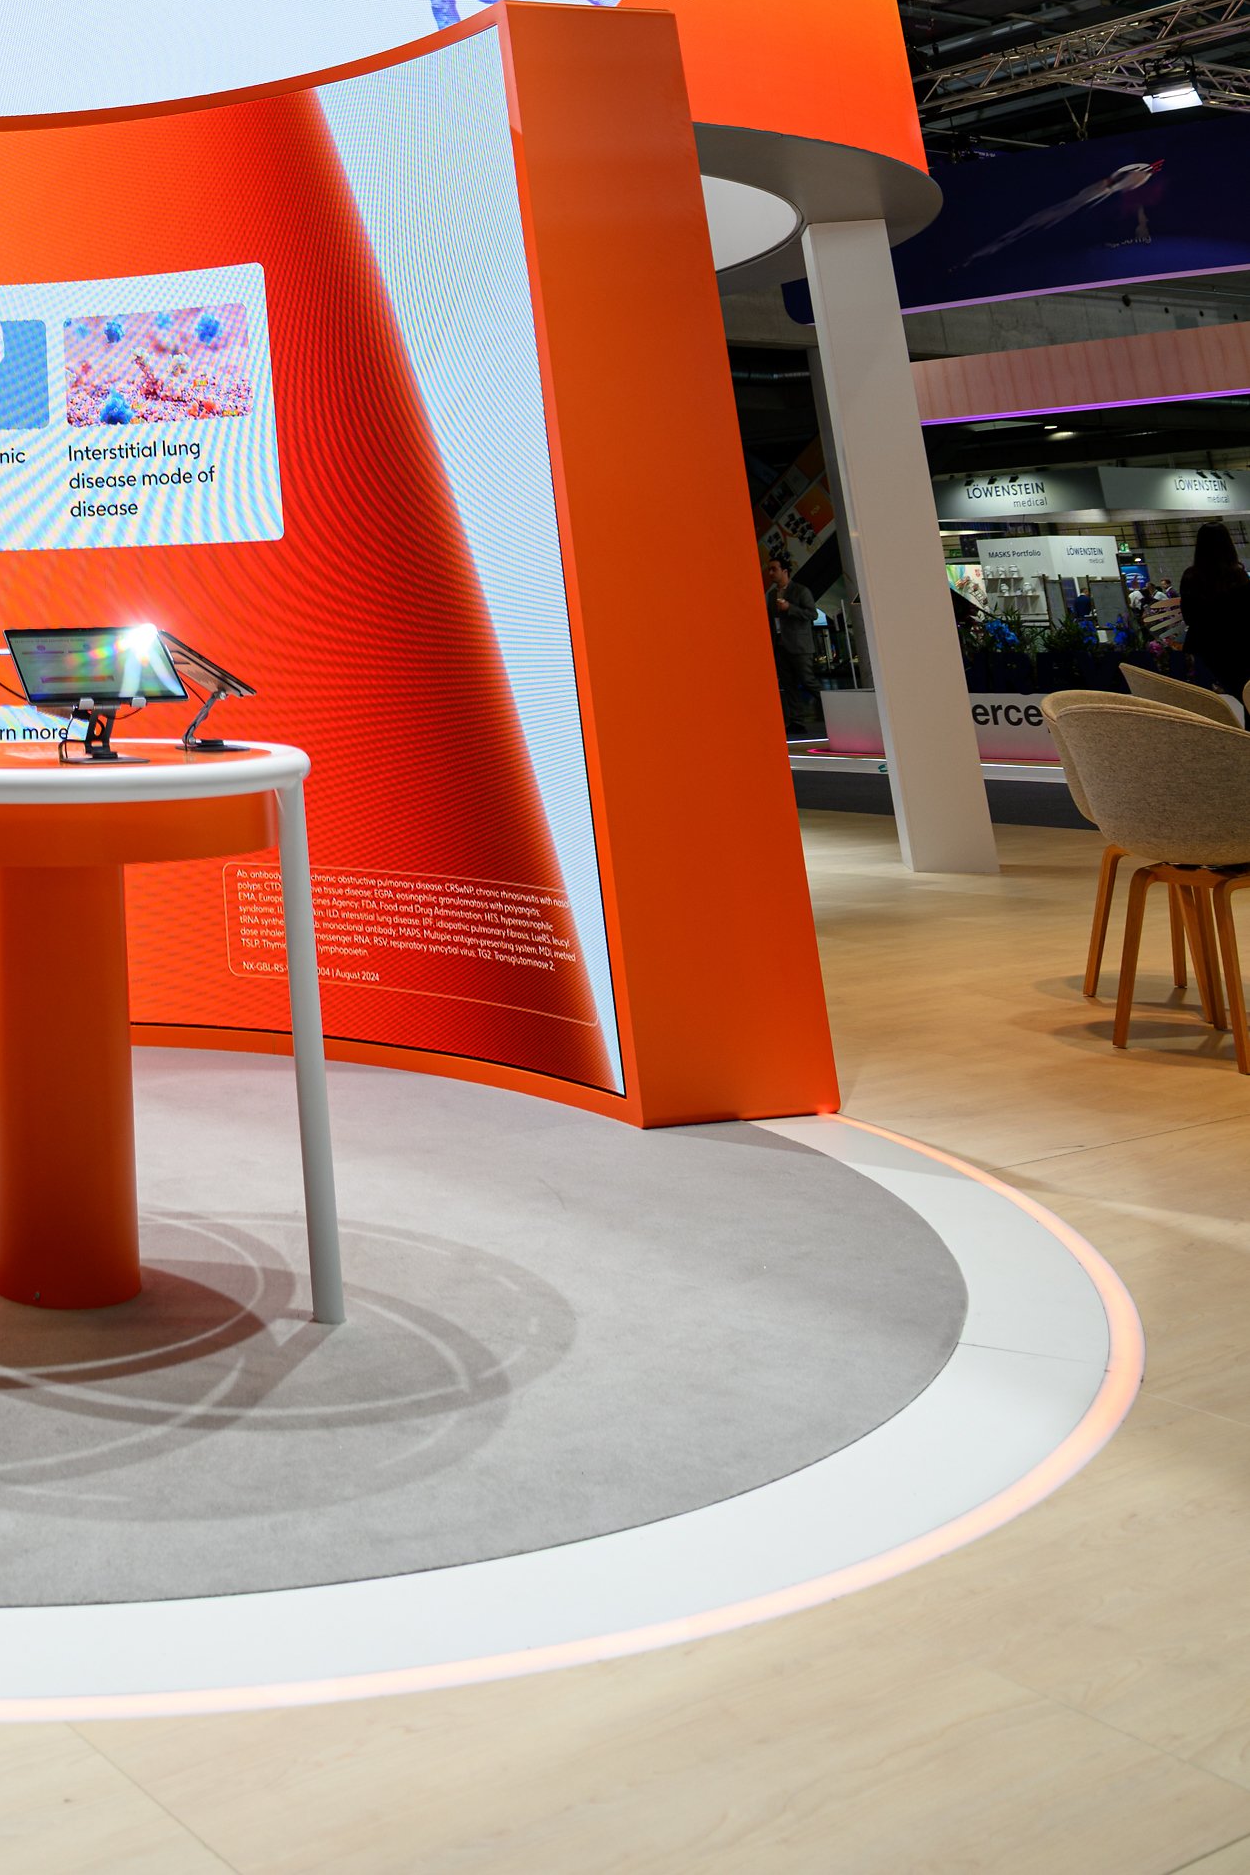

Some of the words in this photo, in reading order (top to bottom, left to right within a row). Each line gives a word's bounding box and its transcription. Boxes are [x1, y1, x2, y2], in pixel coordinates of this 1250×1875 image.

[68, 440, 157, 462] Interstitial
[162, 440, 200, 459] lung
[69, 473, 137, 489] disease
[142, 467, 192, 486] mode
[197, 465, 216, 483] of
[1174, 475, 1227, 491] LÖWENSTEIN
[966, 482, 1046, 500] LÖWENSTEIN
[70, 501, 139, 518] disease
[1013, 497, 1048, 507] medical
[988, 550, 1011, 558] MASKS
[1012, 549, 1041, 557] Portfolio
[1066, 545, 1104, 556] LÖWENSTEIN
[22, 727, 69, 740] more
[310, 873, 336, 883] chronic
[337, 875, 375, 886] obstructive
[377, 878, 415, 891] pulmonary
[475, 886, 500, 898] chronic
[379, 901, 398, 912] Food
[399, 903, 414, 913] and
[414, 904, 433, 916] Drug
[322, 921, 364, 932] monoclonal
[423, 929, 452, 943] Multiple
[376, 913, 392, 924] lung
[470, 924, 506, 938] pulmonary
[240, 927, 258, 936] dose
[390, 940, 427, 953] respiratory
[335, 968, 361, 981] August
[361, 971, 380, 982] 2024
